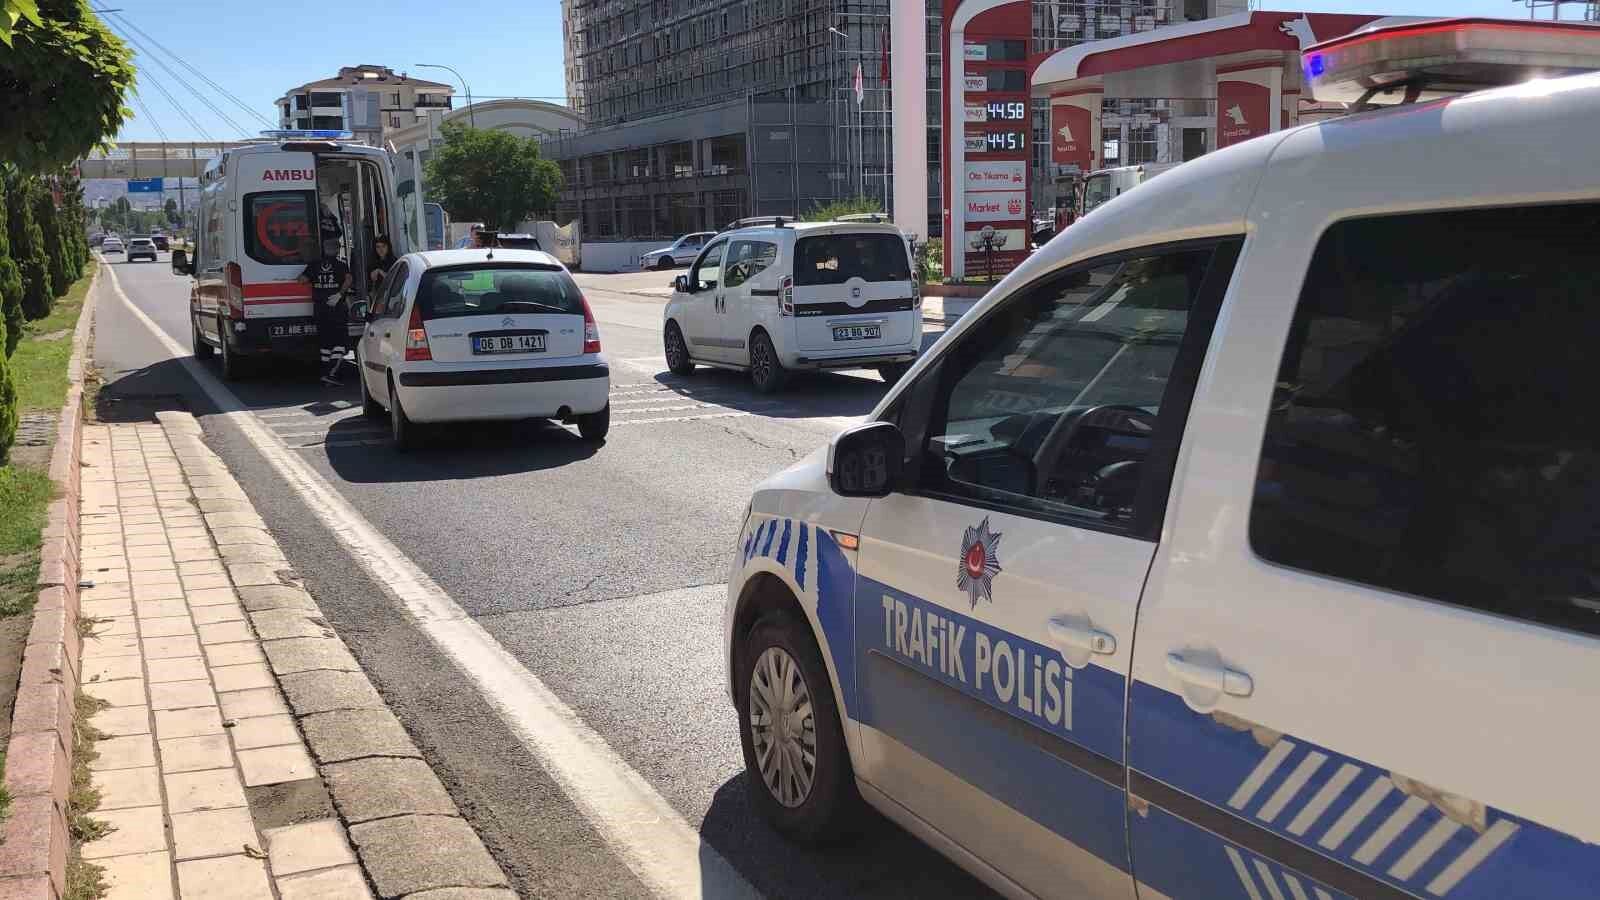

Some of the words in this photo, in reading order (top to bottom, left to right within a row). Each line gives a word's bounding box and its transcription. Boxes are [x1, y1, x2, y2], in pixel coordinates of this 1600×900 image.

[987, 103, 1024, 119] 44.58
[262, 169, 314, 181] AMBU
[968, 202, 1000, 213] Market
[318, 273, 335, 283] 112
[838, 328, 849, 337] 23
[481, 339, 494, 350] 06
[500, 338, 513, 349] DB
[519, 336, 542, 348] 1421
[882, 594, 968, 683] TRAFİK
[975, 631, 1073, 731] POLİSİ
